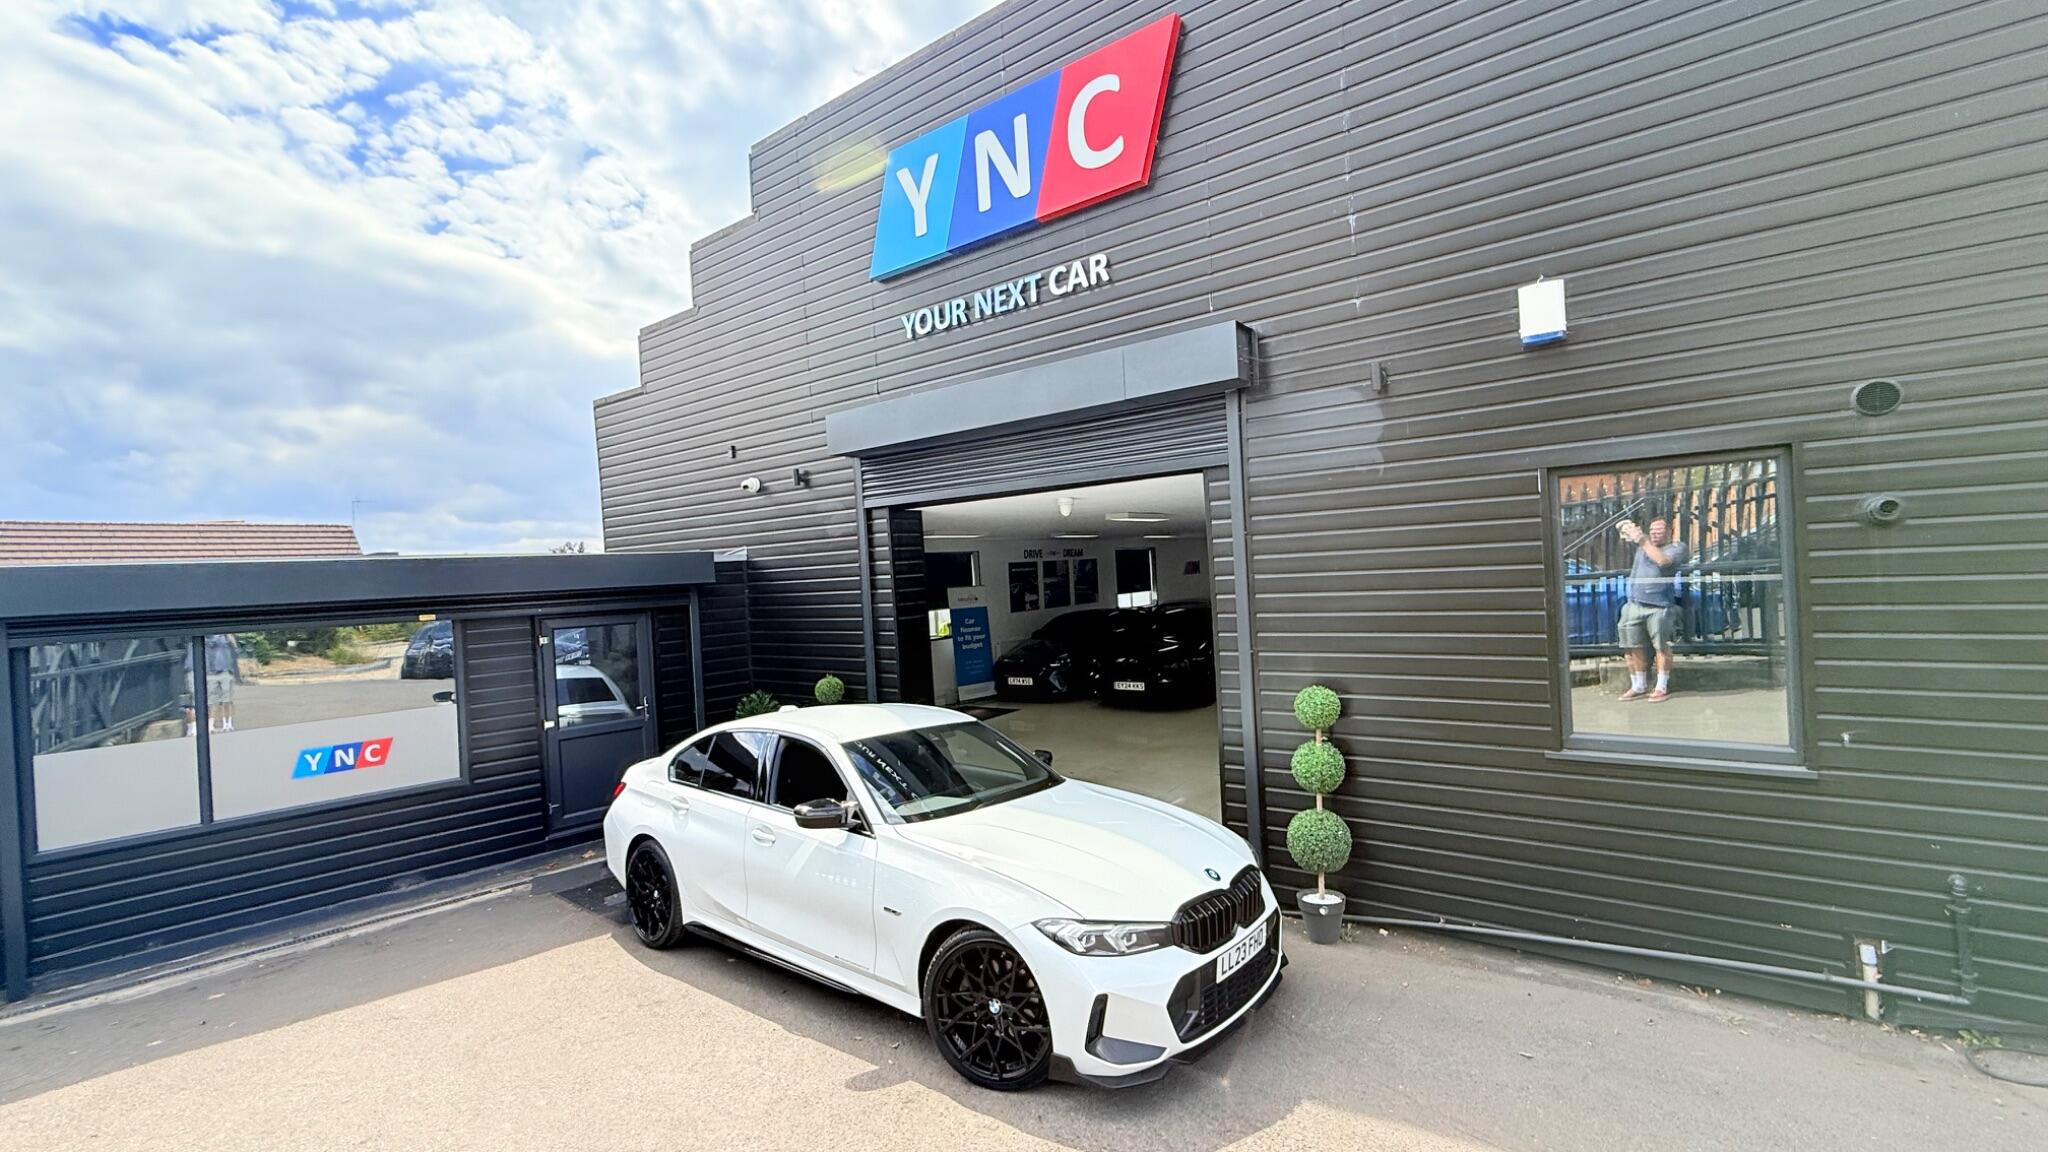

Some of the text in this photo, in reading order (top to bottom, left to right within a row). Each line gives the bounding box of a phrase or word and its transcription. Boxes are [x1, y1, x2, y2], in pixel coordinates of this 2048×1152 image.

[896, 73, 1124, 238] YNC
[901, 253, 1110, 339] YOUR NEXT CAR
[1023, 549, 1043, 559] DRIVE
[304, 744, 381, 772] YNC
[1221, 942, 1247, 975] LL23
